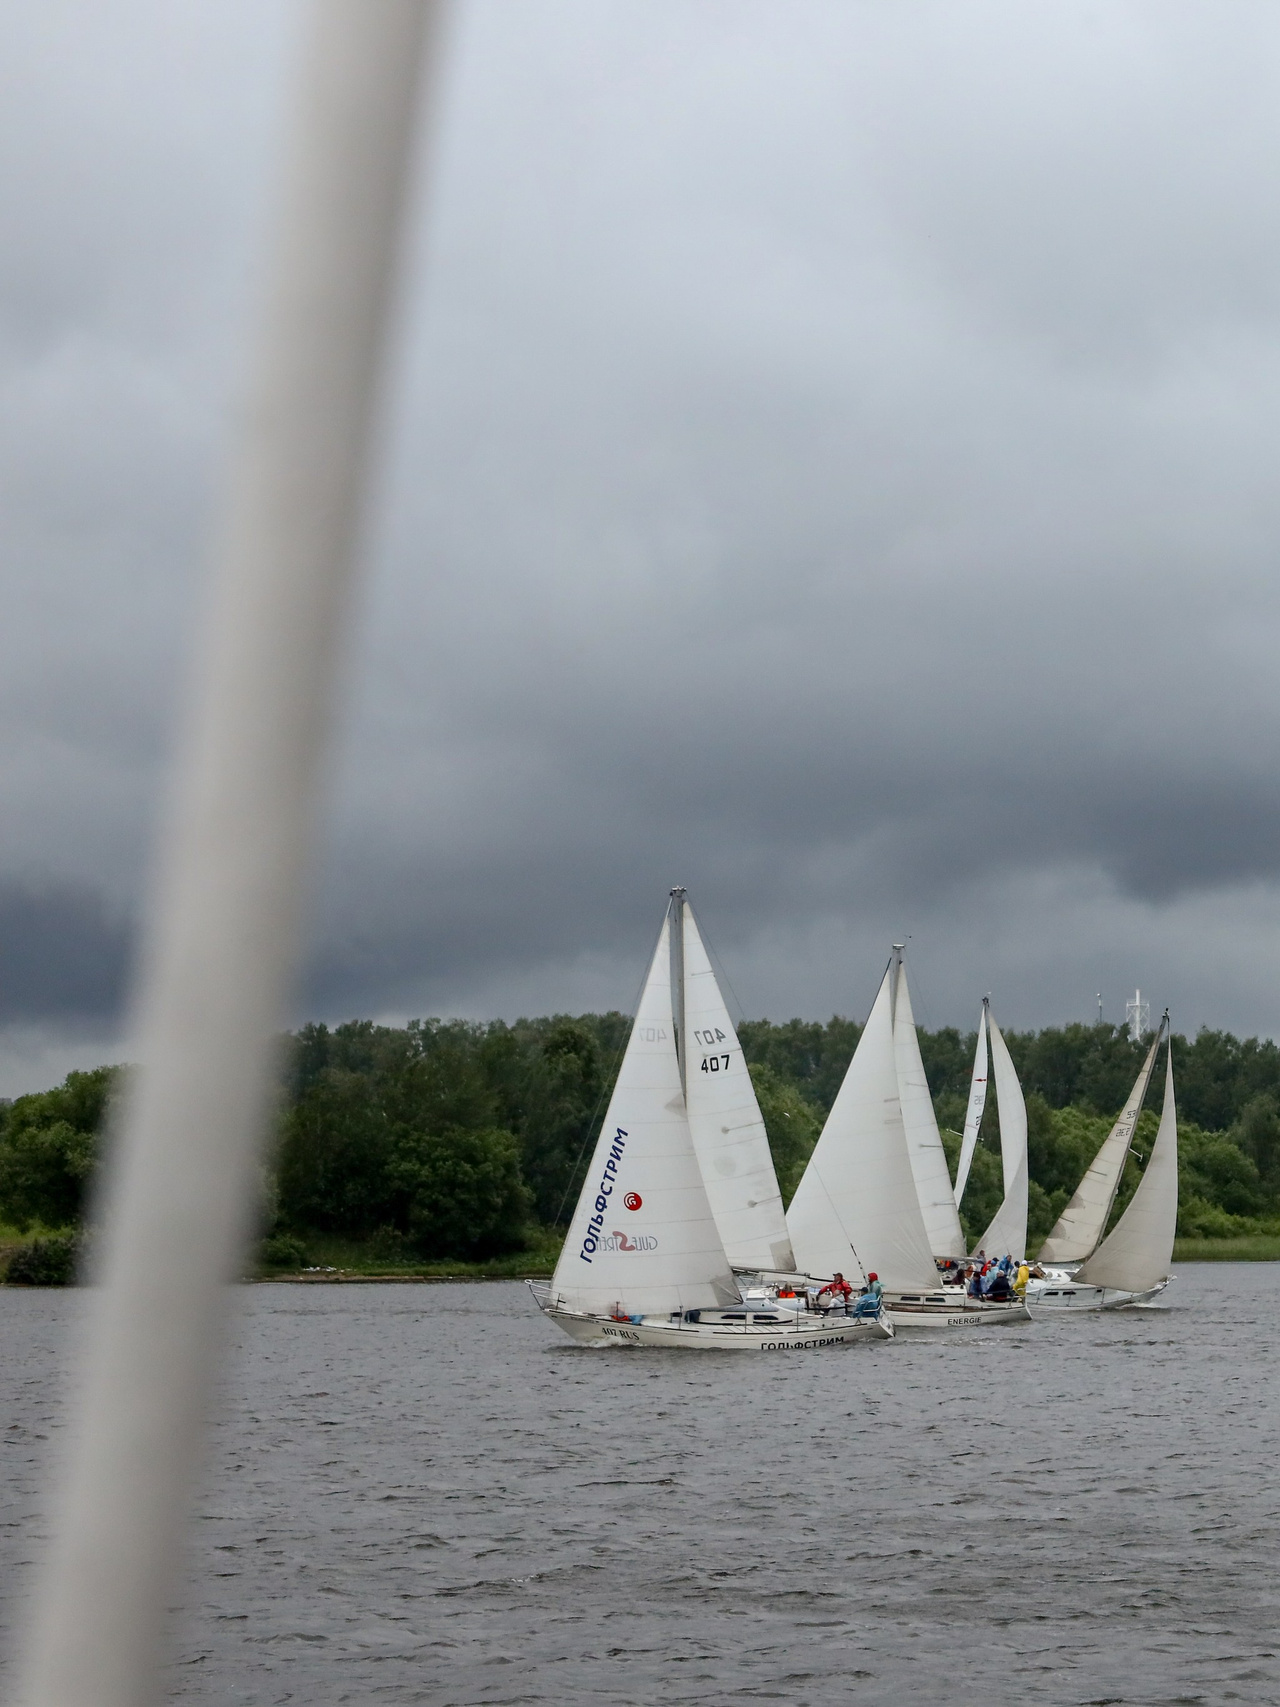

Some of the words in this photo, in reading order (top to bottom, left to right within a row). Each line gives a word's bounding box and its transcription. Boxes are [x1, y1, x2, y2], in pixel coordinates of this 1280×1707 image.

[701, 1054, 730, 1073] 407
[580, 1127, 629, 1264] ГОЛЬФСТРИМ
[947, 1317, 981, 1325] ENERGIE
[602, 1327, 617, 1336] 407
[619, 1329, 640, 1341] RUS
